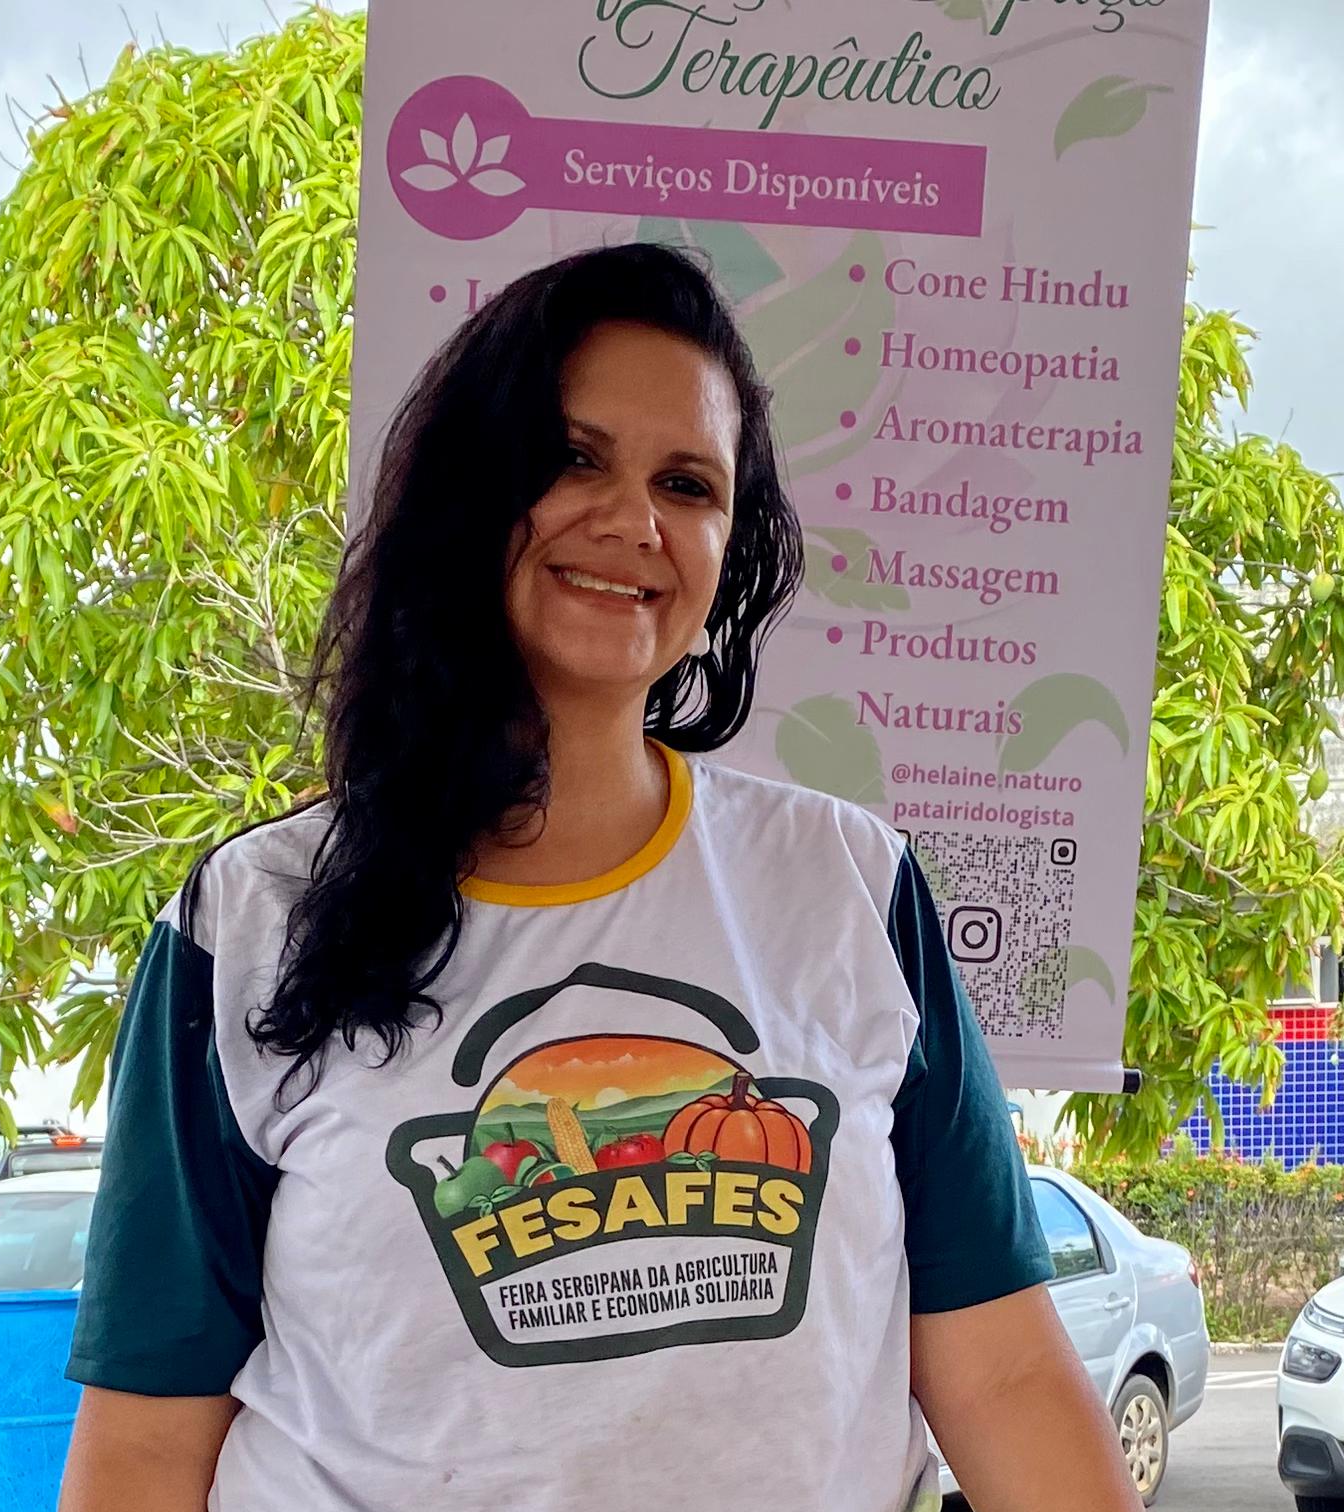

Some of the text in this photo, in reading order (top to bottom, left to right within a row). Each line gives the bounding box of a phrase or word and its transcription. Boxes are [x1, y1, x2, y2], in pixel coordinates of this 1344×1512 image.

[578, 3, 1002, 130] Terapêutico
[563, 147, 940, 211] Serviços Disponíveis
[884, 258, 1130, 311] Cone Hindu
[881, 331, 1120, 387] Homeopatia
[873, 404, 1143, 466] Aromaterapia
[870, 476, 1069, 535] Bandagem
[865, 549, 1060, 604] Massagem
[860, 620, 1037, 665] Produtos
[856, 691, 1023, 736] Naturais
[891, 763, 1083, 794] @helaine.naturo
[893, 800, 1075, 829] patairidologista
[451, 1171, 805, 1277] FESAFES
[499, 1251, 778, 1309] FEIRA SERGIPANA DA AGRICULTURA
[509, 1274, 775, 1331] FAMILIAR E ECONOMIA SOLIDÁRIA
